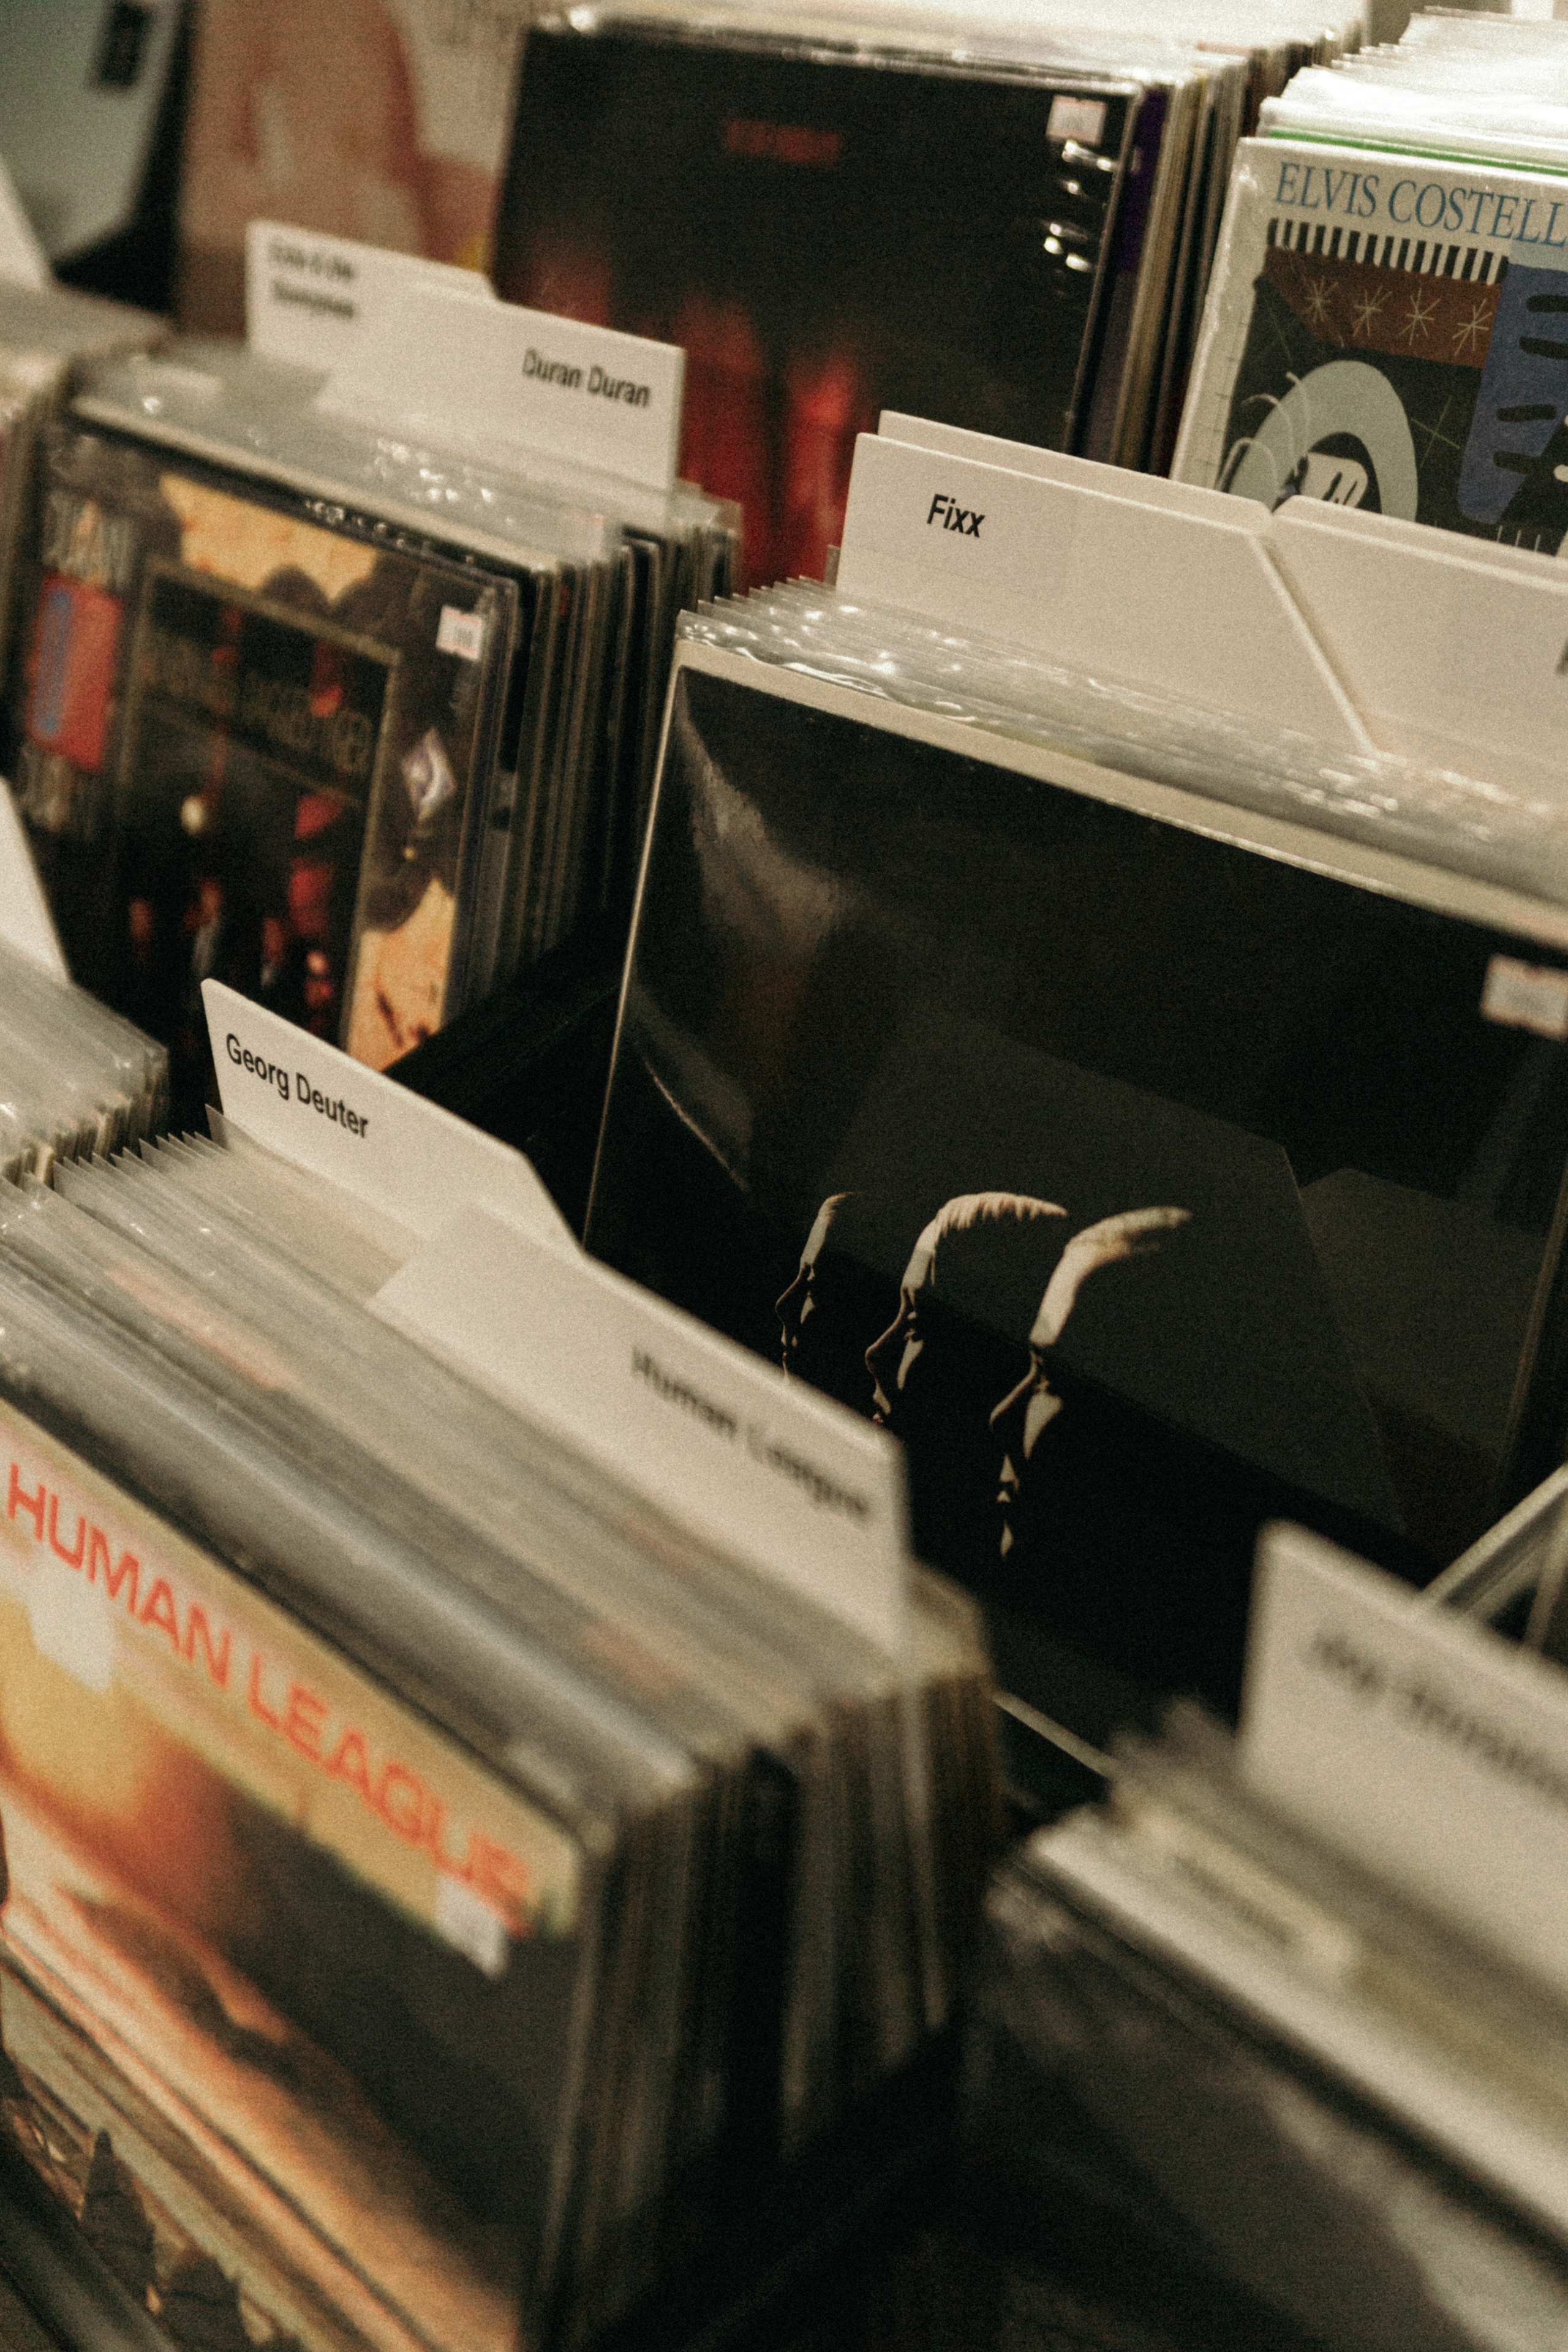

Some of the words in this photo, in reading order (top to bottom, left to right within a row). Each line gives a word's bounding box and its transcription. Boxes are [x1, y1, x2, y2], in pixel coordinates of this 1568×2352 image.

[1272, 161, 1381, 218] ELVIS
[522, 347, 582, 389] Duran
[587, 365, 651, 409] Duran
[926, 493, 986, 538] Fixx
[226, 1033, 289, 1101] Georg
[296, 1072, 369, 1138] Deuter
[7, 1462, 232, 1691] HUMAN
